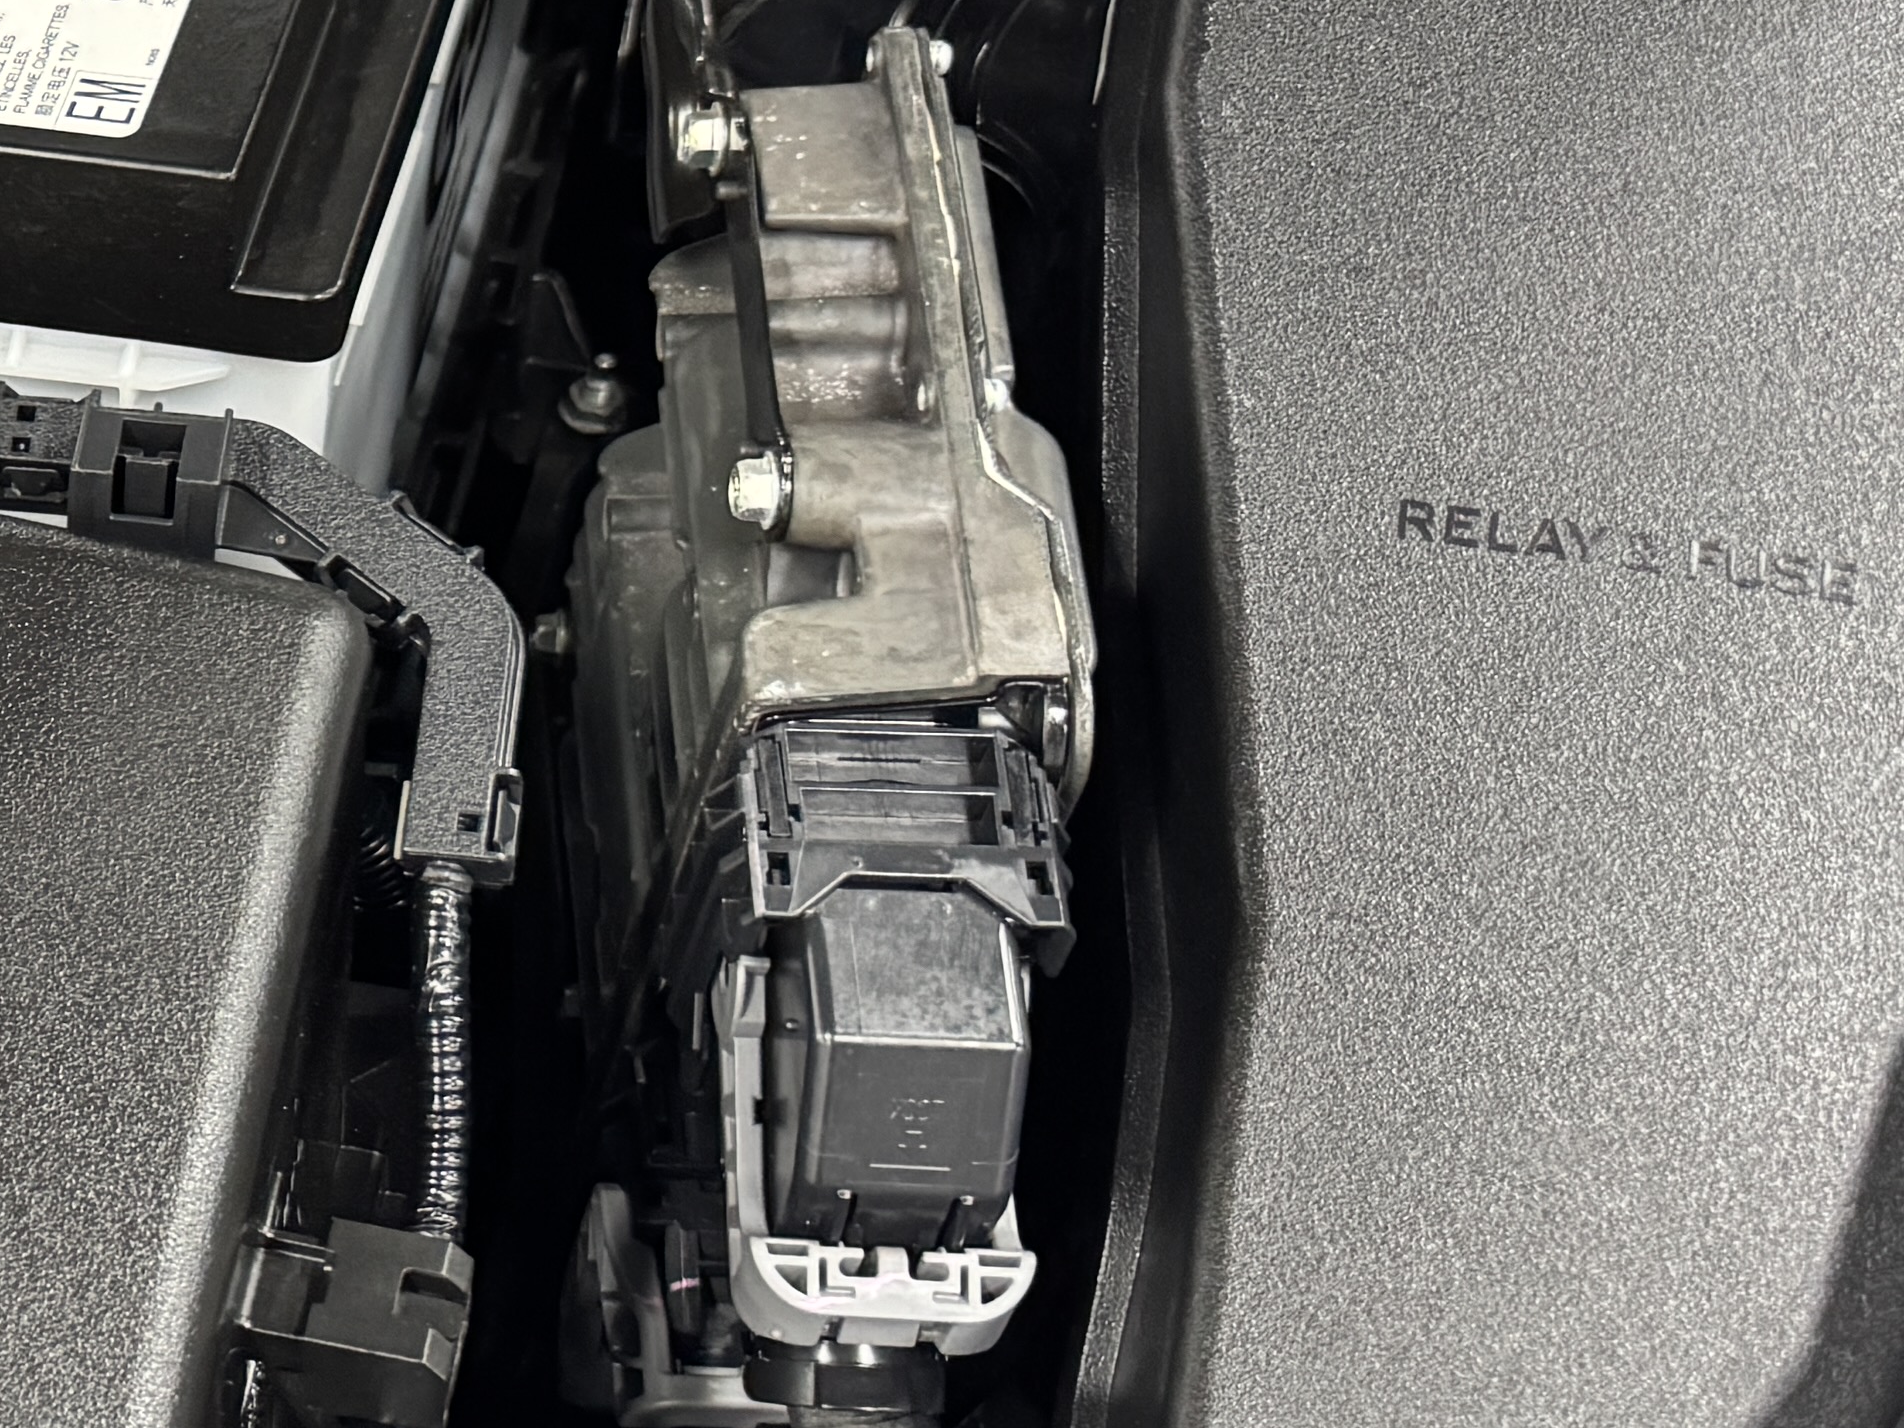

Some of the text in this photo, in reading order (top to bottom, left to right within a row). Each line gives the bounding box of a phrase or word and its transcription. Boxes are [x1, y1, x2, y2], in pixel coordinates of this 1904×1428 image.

[58, 40, 79, 61] 12V
[64, 77, 146, 124] EM
[1397, 498, 1860, 606] RELAY & FUSE
